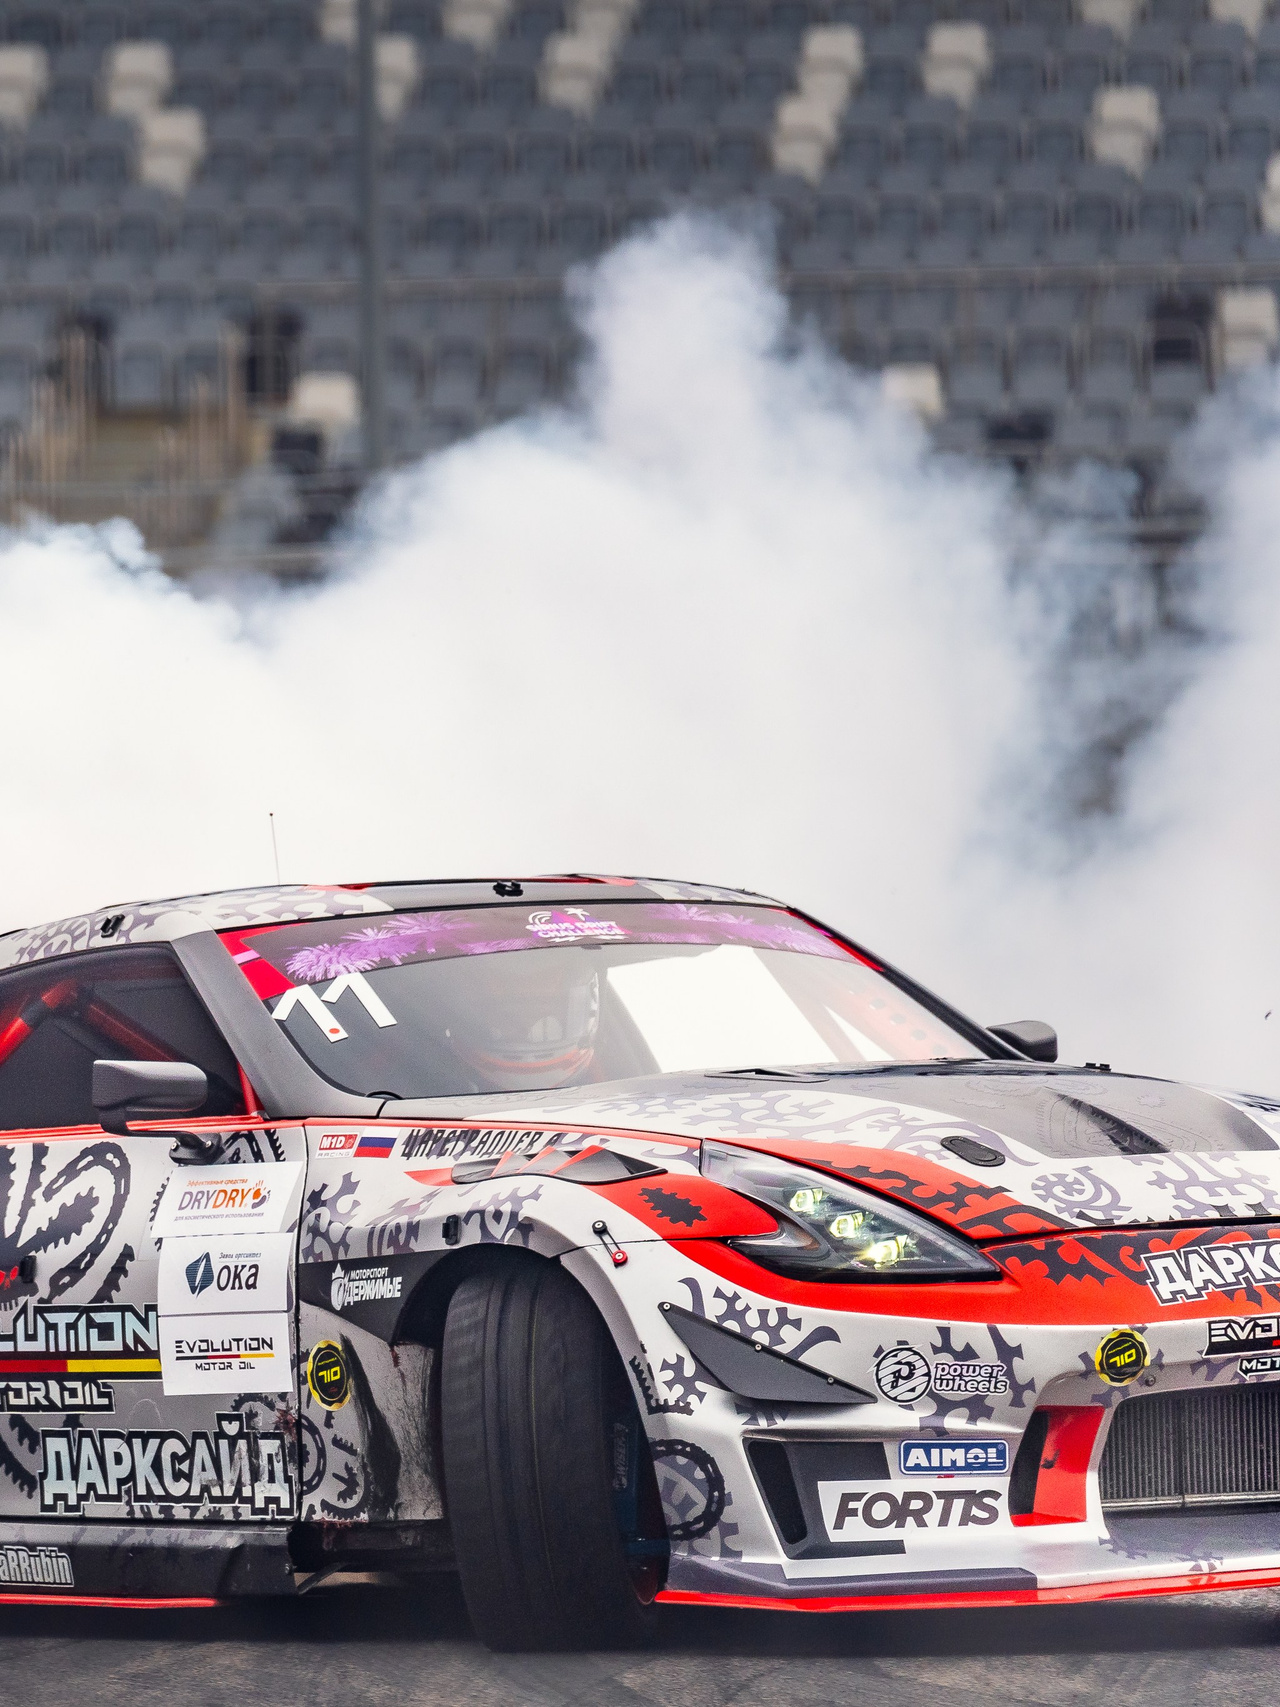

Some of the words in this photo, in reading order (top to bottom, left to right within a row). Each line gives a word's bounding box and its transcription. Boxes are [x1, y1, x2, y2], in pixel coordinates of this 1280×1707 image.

[271, 972, 398, 1044] 11
[178, 1188, 252, 1211] DRYDRY
[350, 1267, 389, 1280] МОТОРСПОРТ
[175, 1337, 273, 1354] EVOLUTION
[196, 1362, 233, 1371] MOTOR
[239, 1361, 255, 1370] OIL
[936, 1363, 1003, 1379] power
[63, 1381, 109, 1406] OIL
[934, 1377, 1007, 1393] wheels
[43, 1420, 290, 1509] ДАРКСАЙД
[905, 1447, 1004, 1467] AIMOL
[833, 1489, 1003, 1531] FORTIS
